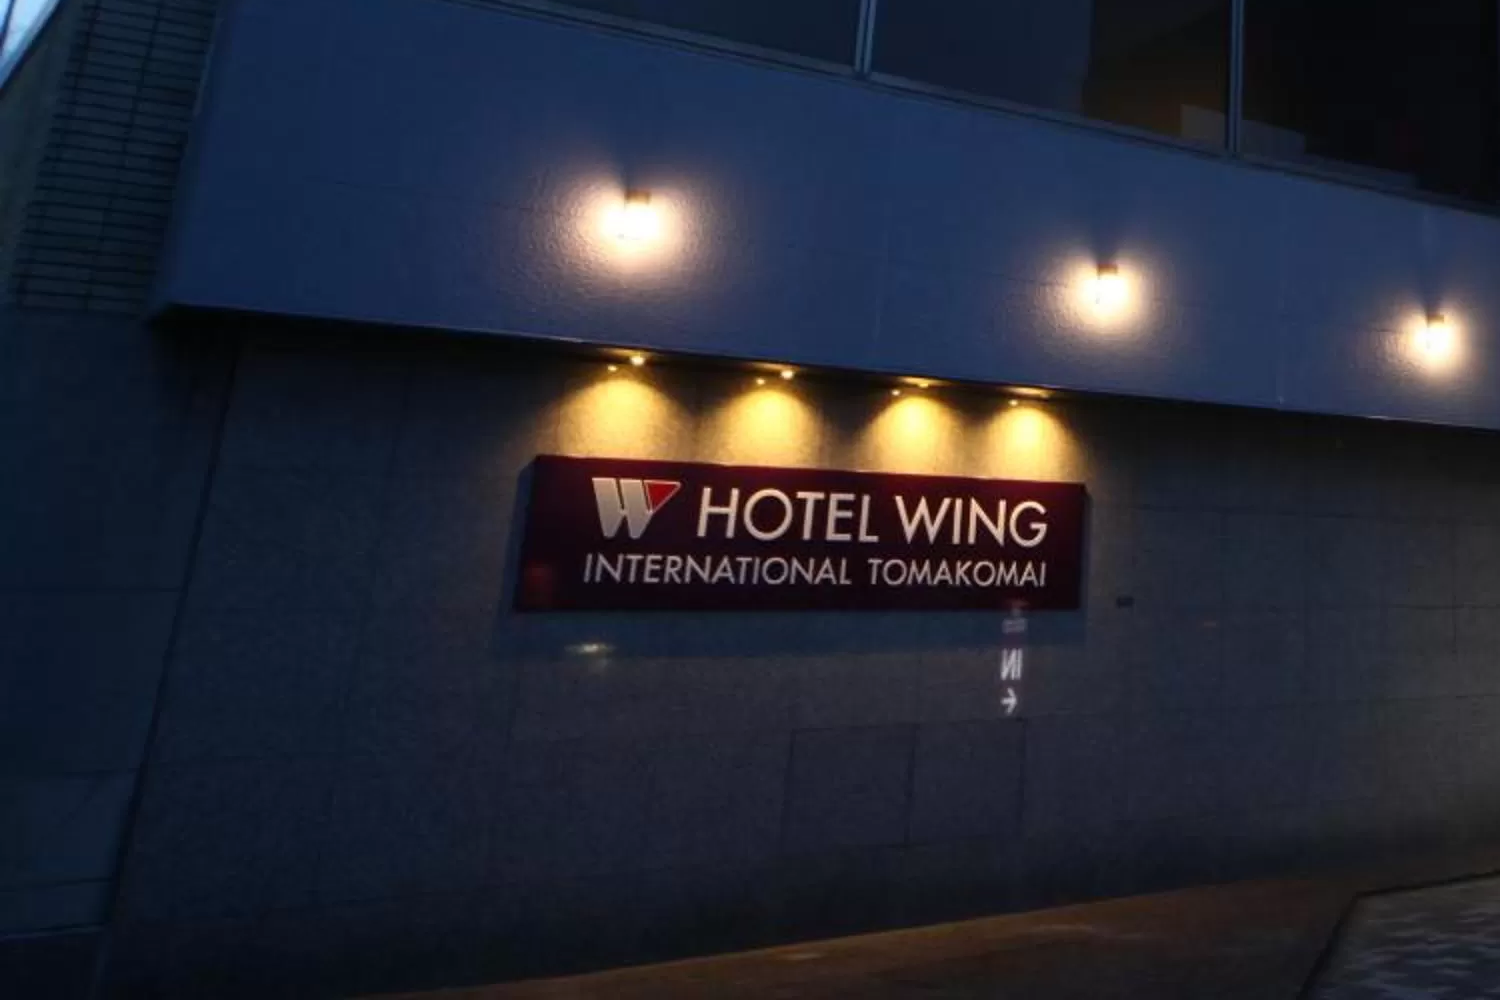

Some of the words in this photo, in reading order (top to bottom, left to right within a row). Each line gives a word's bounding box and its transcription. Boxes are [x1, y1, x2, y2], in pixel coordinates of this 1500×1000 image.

[696, 486, 879, 543] HOTEL
[895, 494, 1048, 548] WING
[583, 553, 852, 586] INTERNATIONAL
[867, 558, 1047, 588] TOMAKOMAI
